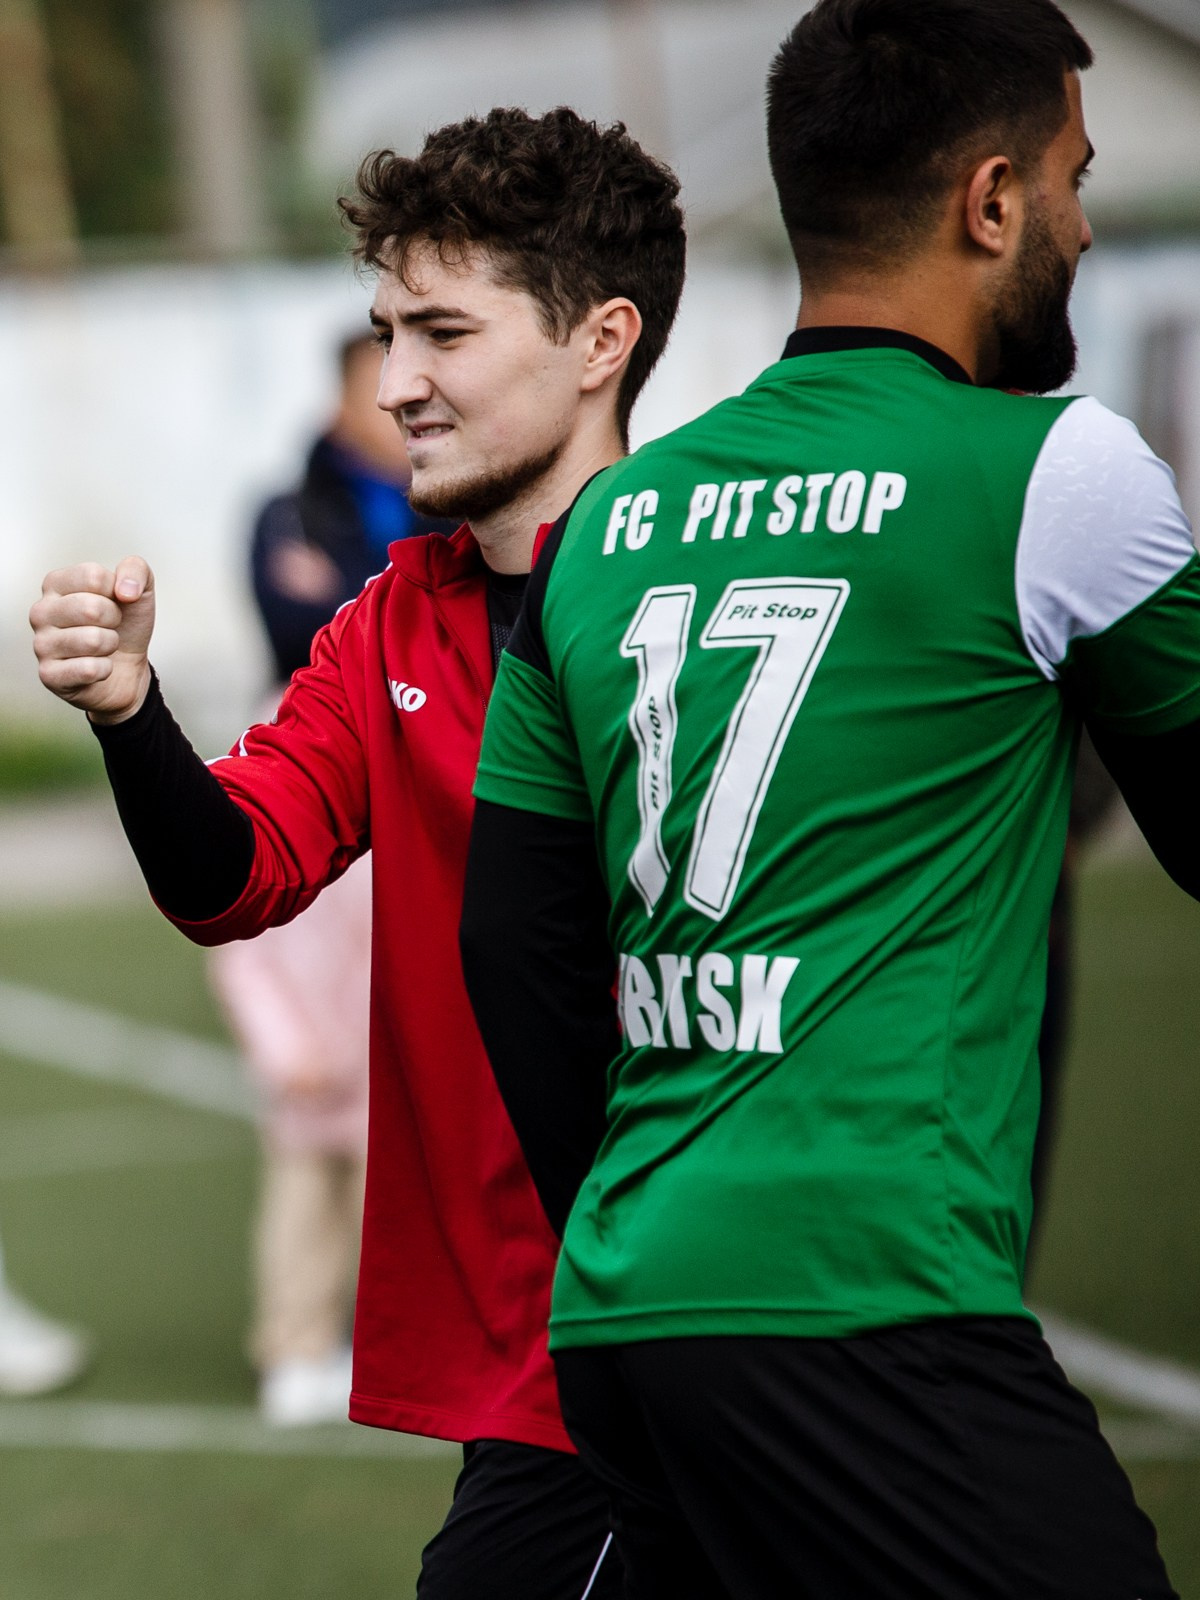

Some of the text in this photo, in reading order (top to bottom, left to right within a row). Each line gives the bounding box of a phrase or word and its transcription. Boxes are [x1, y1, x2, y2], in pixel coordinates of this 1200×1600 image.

[602, 470, 907, 555] FC PIT STOP
[727, 602, 819, 621] Pit Stop
[387, 676, 427, 713] KO
[620, 577, 851, 923] 17
